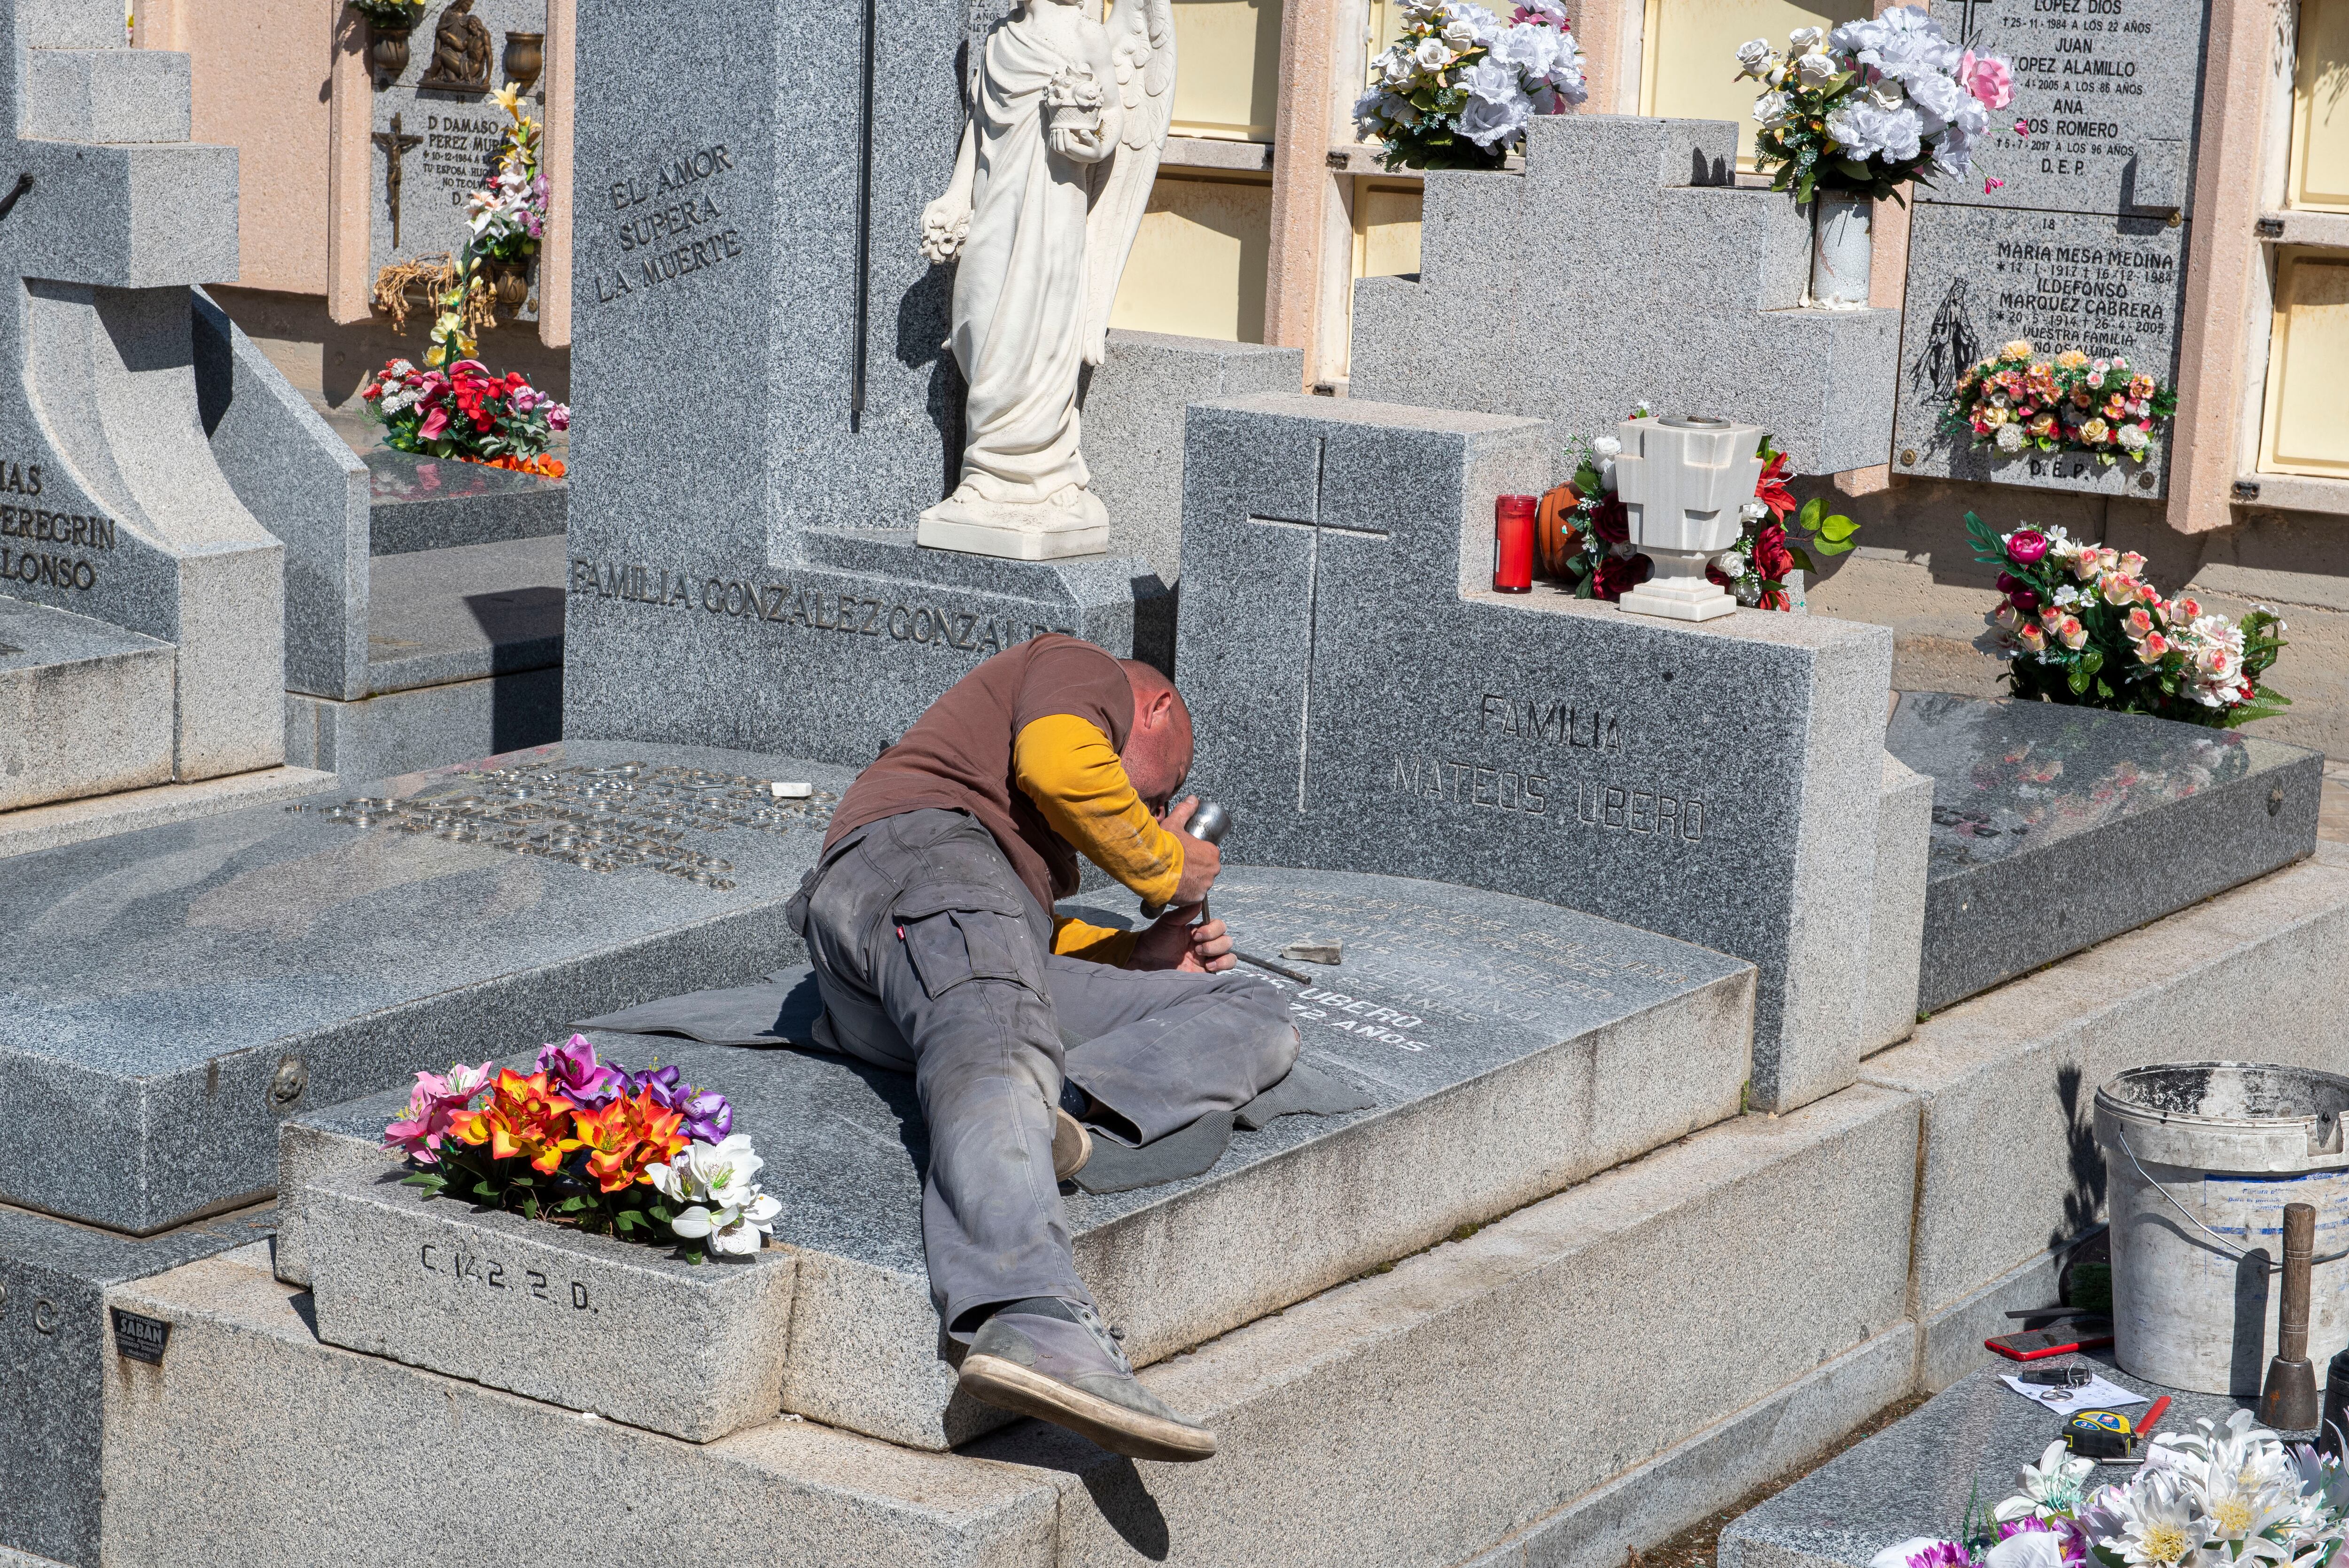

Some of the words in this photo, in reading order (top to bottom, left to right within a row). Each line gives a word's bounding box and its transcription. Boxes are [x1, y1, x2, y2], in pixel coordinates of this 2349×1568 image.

[2034, 0, 2080, 13] LOPEZ
[2088, 0, 2122, 15] DIOS
[2047, 19, 2067, 29] 1984
[2072, 20, 2078, 30] A
[2084, 21, 2103, 31] LOS
[2108, 22, 2118, 32] 22
[2123, 21, 2152, 34] AÑOS
[2055, 38, 2092, 54] JUAN
[2063, 59, 2136, 77] ALAMILLO
[2038, 79, 2059, 91] 2005
[2063, 81, 2071, 91] A
[2076, 81, 2094, 93] LOS
[2116, 81, 2143, 95] AÑOS
[2053, 99, 2084, 115] ANA
[428, 116, 438, 130] D
[443, 117, 499, 135] DAMASO
[2056, 120, 2118, 138] ROMERO
[429, 133, 467, 151] PEREZ
[2031, 140, 2050, 151] 2017
[2055, 141, 2062, 152] A
[2068, 142, 2086, 154] LOS
[2092, 143, 2102, 155] 96
[2107, 142, 2134, 156] AÑOS
[474, 154, 480, 163] A
[423, 163, 433, 172] TU
[436, 164, 466, 176] ESPOSA
[611, 177, 649, 210] EL
[658, 143, 733, 195] AMOR
[443, 178, 454, 186] NO
[620, 194, 723, 250] SUPERA
[2042, 218, 2055, 230] 18
[596, 269, 632, 302] LA
[641, 227, 743, 287] MUERTE
[1998, 242, 2052, 262] MARIA
[2056, 247, 2103, 264] MESA
[2108, 250, 2173, 270] MEDINA
[2011, 262, 2023, 273] 17
[2051, 264, 2077, 277] 1917
[2097, 267, 2109, 280] 16
[2121, 269, 2133, 282] 12
[2145, 270, 2172, 284] 1984
[2037, 278, 2128, 299] ILDEFONSO
[1999, 292, 2080, 314] MARQUEZ
[2085, 298, 2163, 319] CABRERA
[2008, 311, 2022, 323] 20
[2032, 313, 2039, 325] 5
[2050, 314, 2077, 327] 1914
[2094, 318, 2108, 330] 26
[2118, 319, 2126, 331] 4
[2135, 321, 2164, 335] 2005
[2034, 342, 2051, 353] NO
[2054, 343, 2069, 355] OS
[2083, 330, 2133, 346] FAMILIA
[572, 555, 694, 609] FAMILIA
[704, 576, 883, 636] GONZALEZ
[888, 603, 1078, 652] GONZAL
[1480, 692, 1622, 753] FAMILIA
[1393, 753, 1550, 815] MATEOS
[1579, 781, 1705, 843] UBERO
[553, 823, 732, 870] CORDERO
[1340, 895, 1514, 932] MATEOS
[1315, 920, 1474, 958] MATEOS
[1477, 956, 1620, 1001] UBERO
[1353, 962, 1546, 1022] SERRANO
[1298, 987, 1424, 1029] UBERO
[1331, 1019, 1432, 1052] AÑOS
[121, 1318, 162, 1344] SABÁN
[128, 1349, 144, 1358] Madrid
